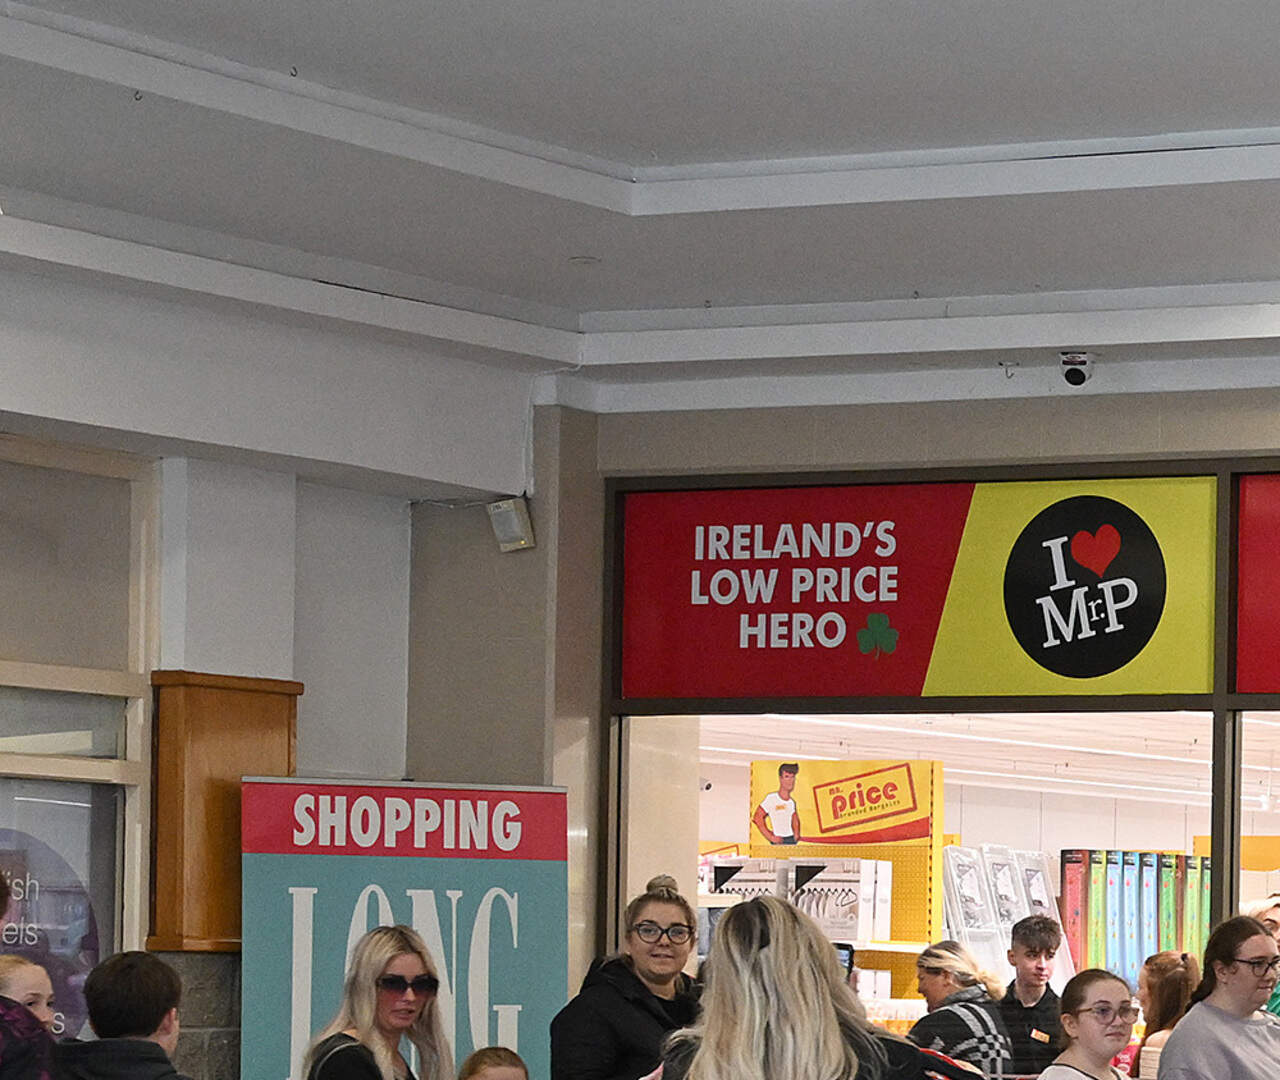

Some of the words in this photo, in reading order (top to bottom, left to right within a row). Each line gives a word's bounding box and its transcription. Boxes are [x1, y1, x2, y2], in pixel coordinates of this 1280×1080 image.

[694, 520, 897, 560] IRELAND'S
[691, 569, 779, 605] LOW
[791, 565, 898, 603] PRICE
[739, 612, 847, 649] HERO
[832, 782, 898, 820] price
[293, 793, 522, 852] SHOPPING
